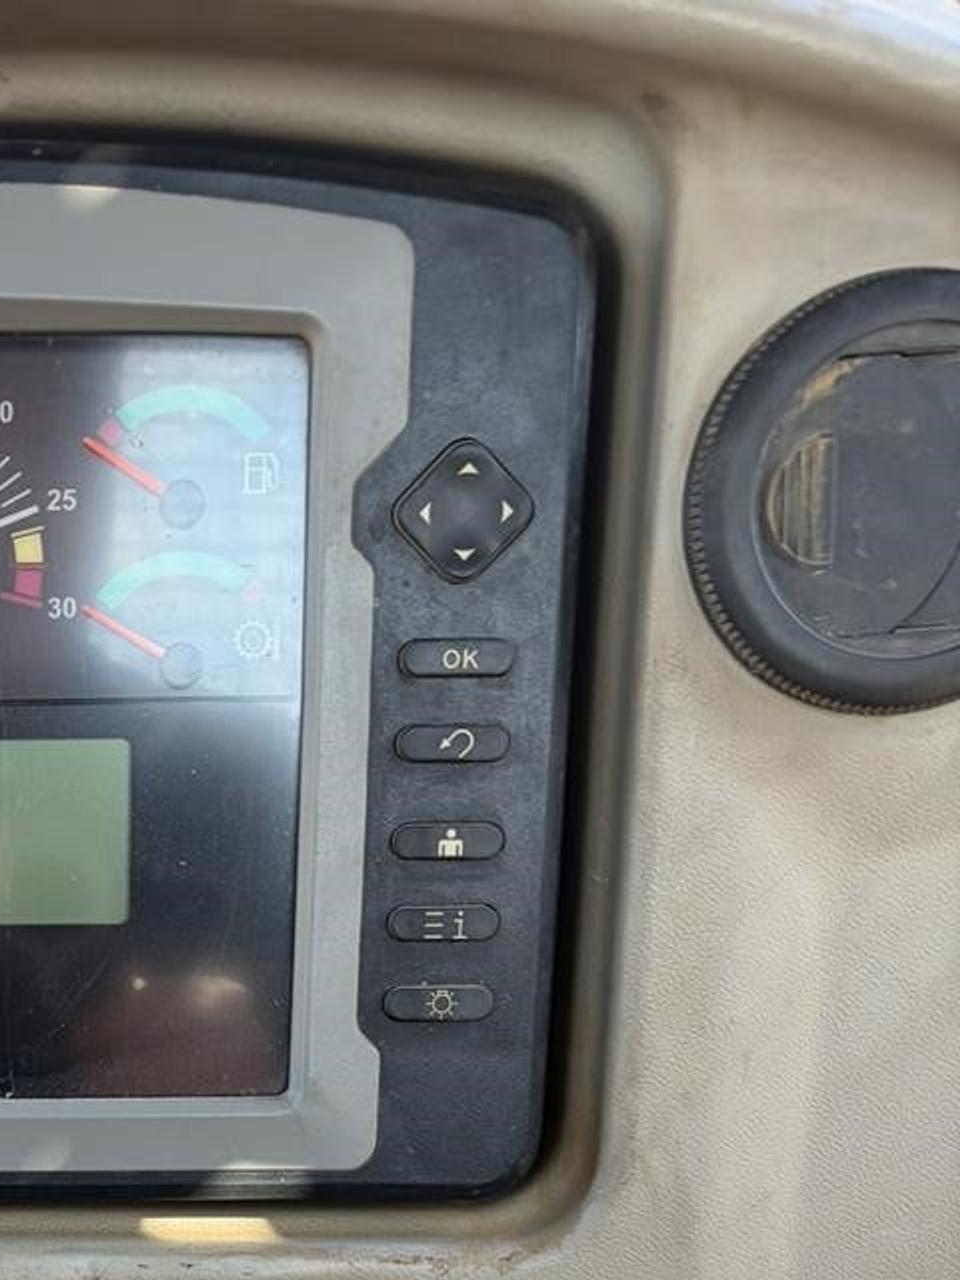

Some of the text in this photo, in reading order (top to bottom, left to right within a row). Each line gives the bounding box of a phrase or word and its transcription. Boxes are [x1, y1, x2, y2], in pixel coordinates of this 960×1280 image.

[46, 488, 77, 511] 25
[47, 596, 77, 619] 30
[442, 648, 479, 670] OK
